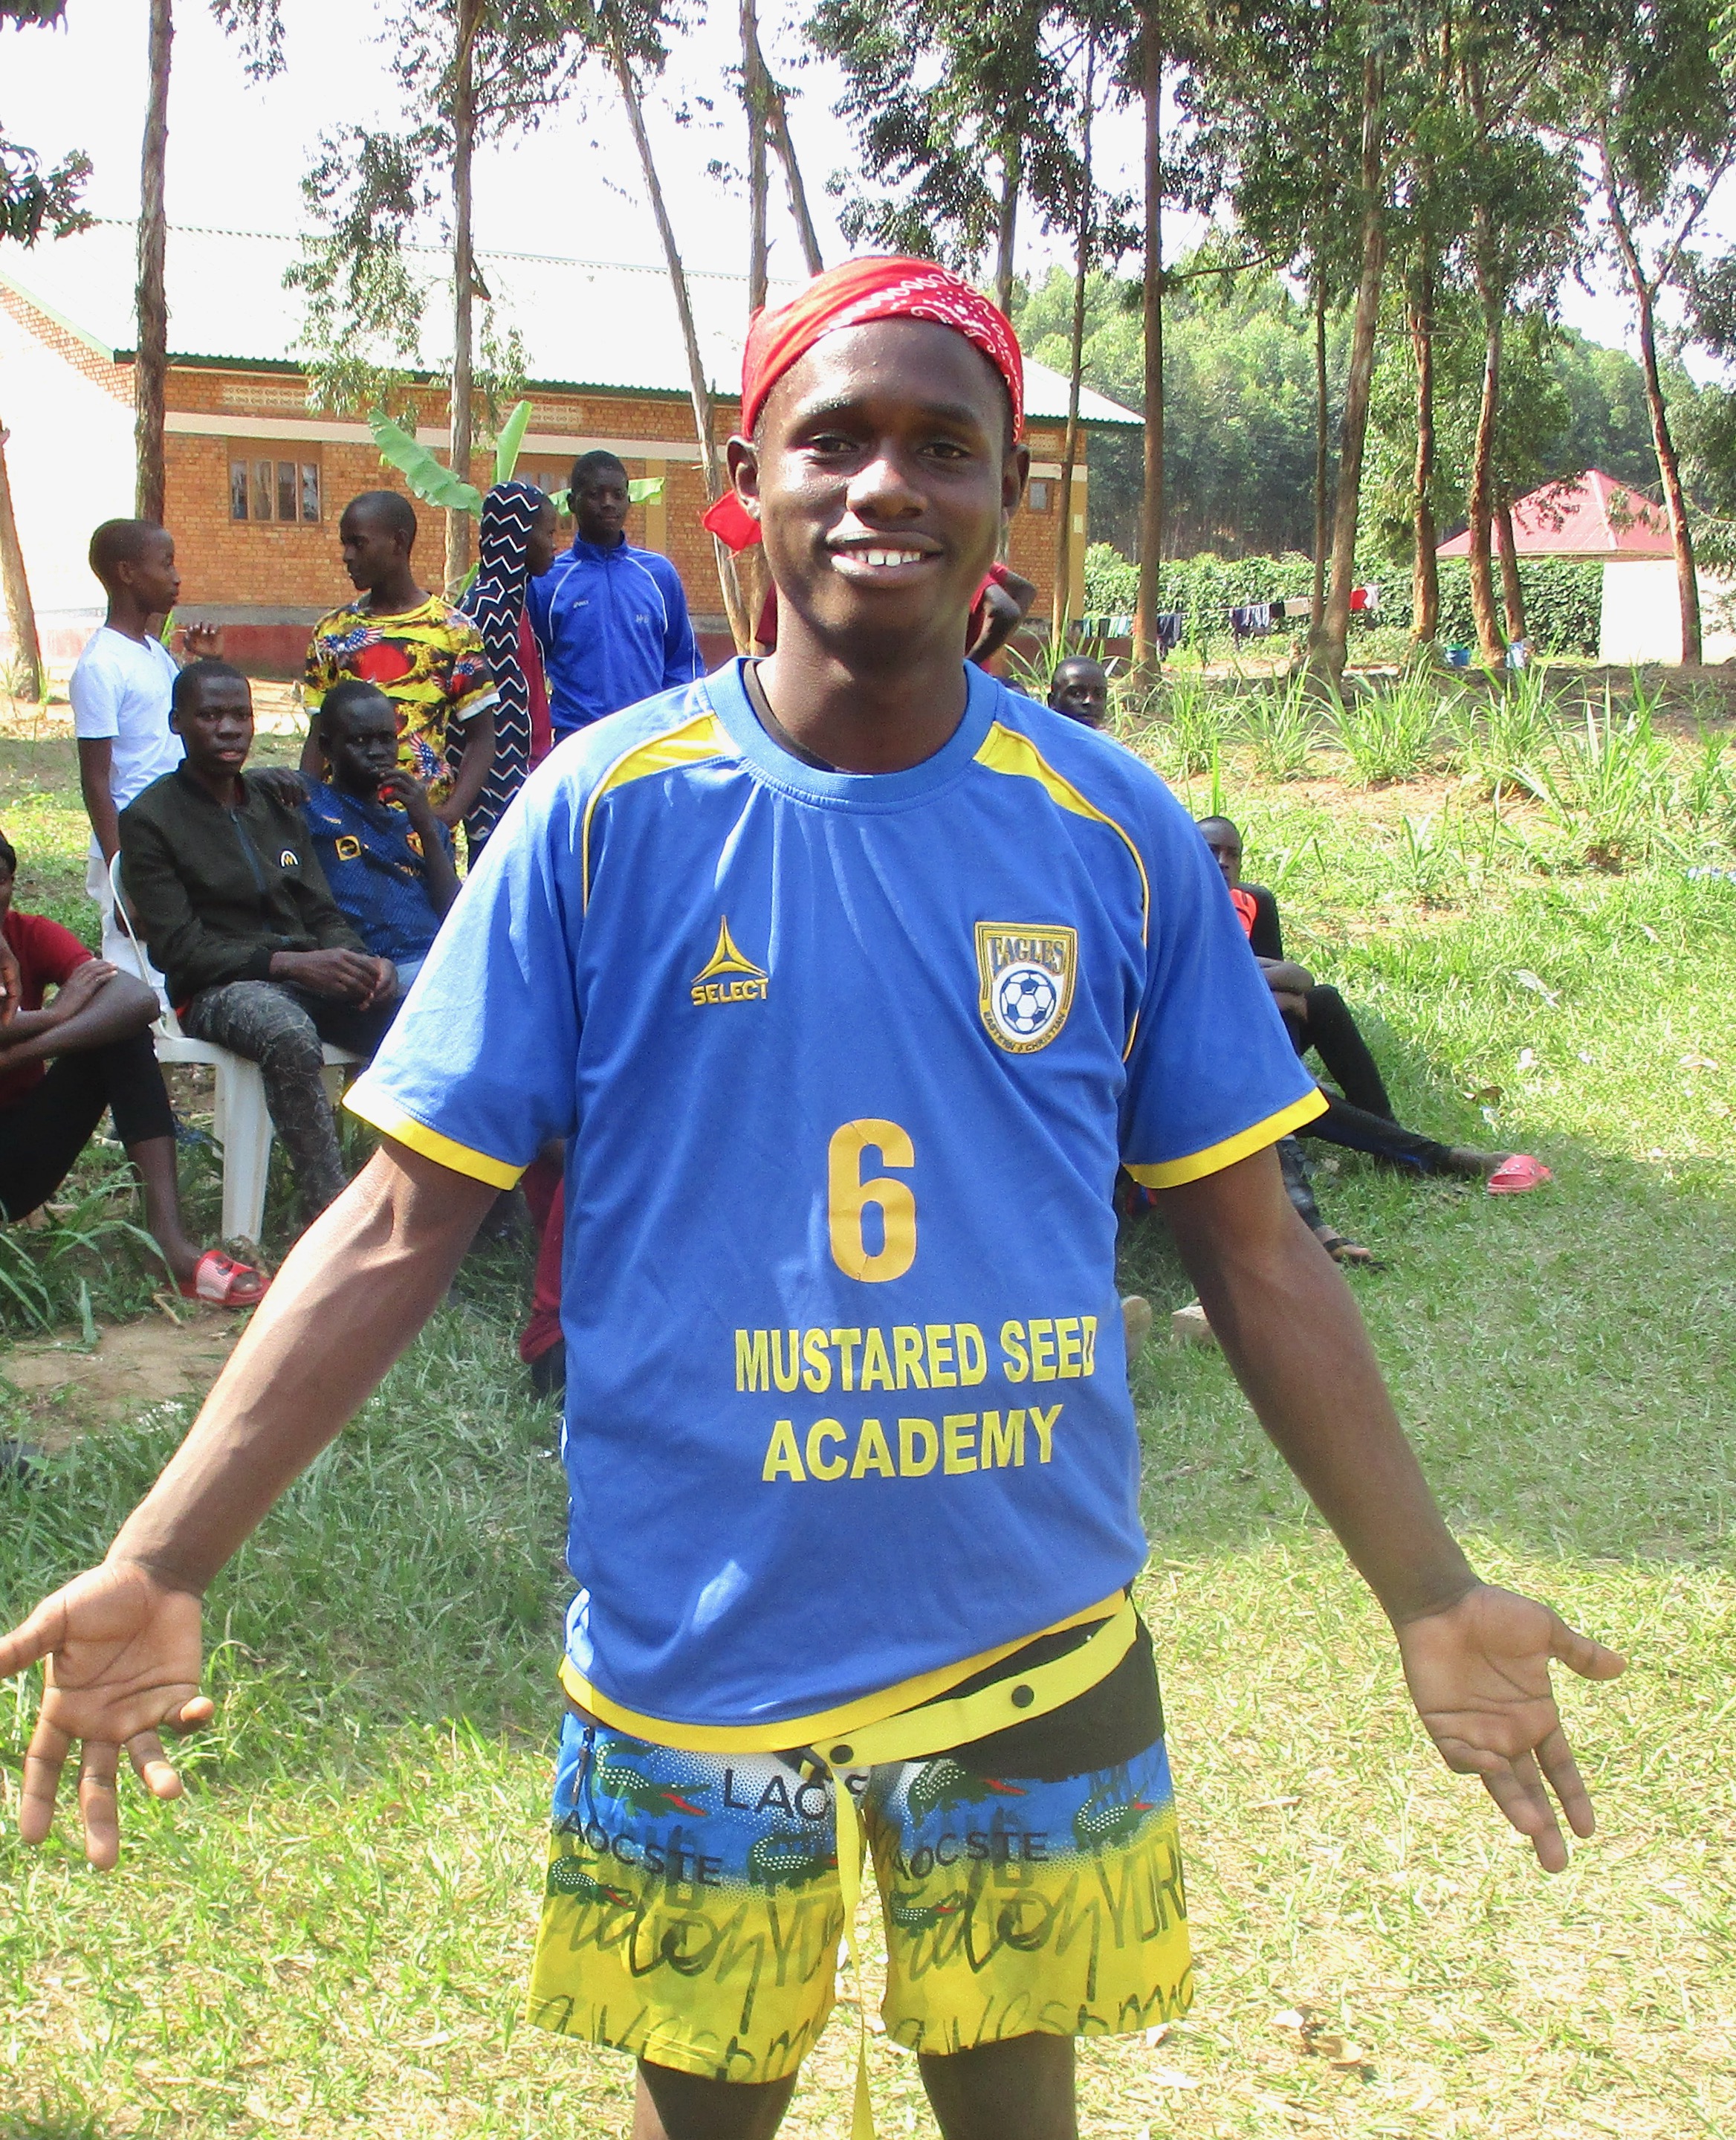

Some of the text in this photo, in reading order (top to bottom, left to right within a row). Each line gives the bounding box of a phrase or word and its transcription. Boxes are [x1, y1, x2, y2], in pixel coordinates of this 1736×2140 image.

[690, 977, 769, 1006] SELECT
[989, 937, 1064, 980] EAGLES
[828, 1118, 917, 1283] 6
[735, 1315, 1098, 1394] MUSTARED SEED
[762, 1403, 1064, 1482] ACADEMY
